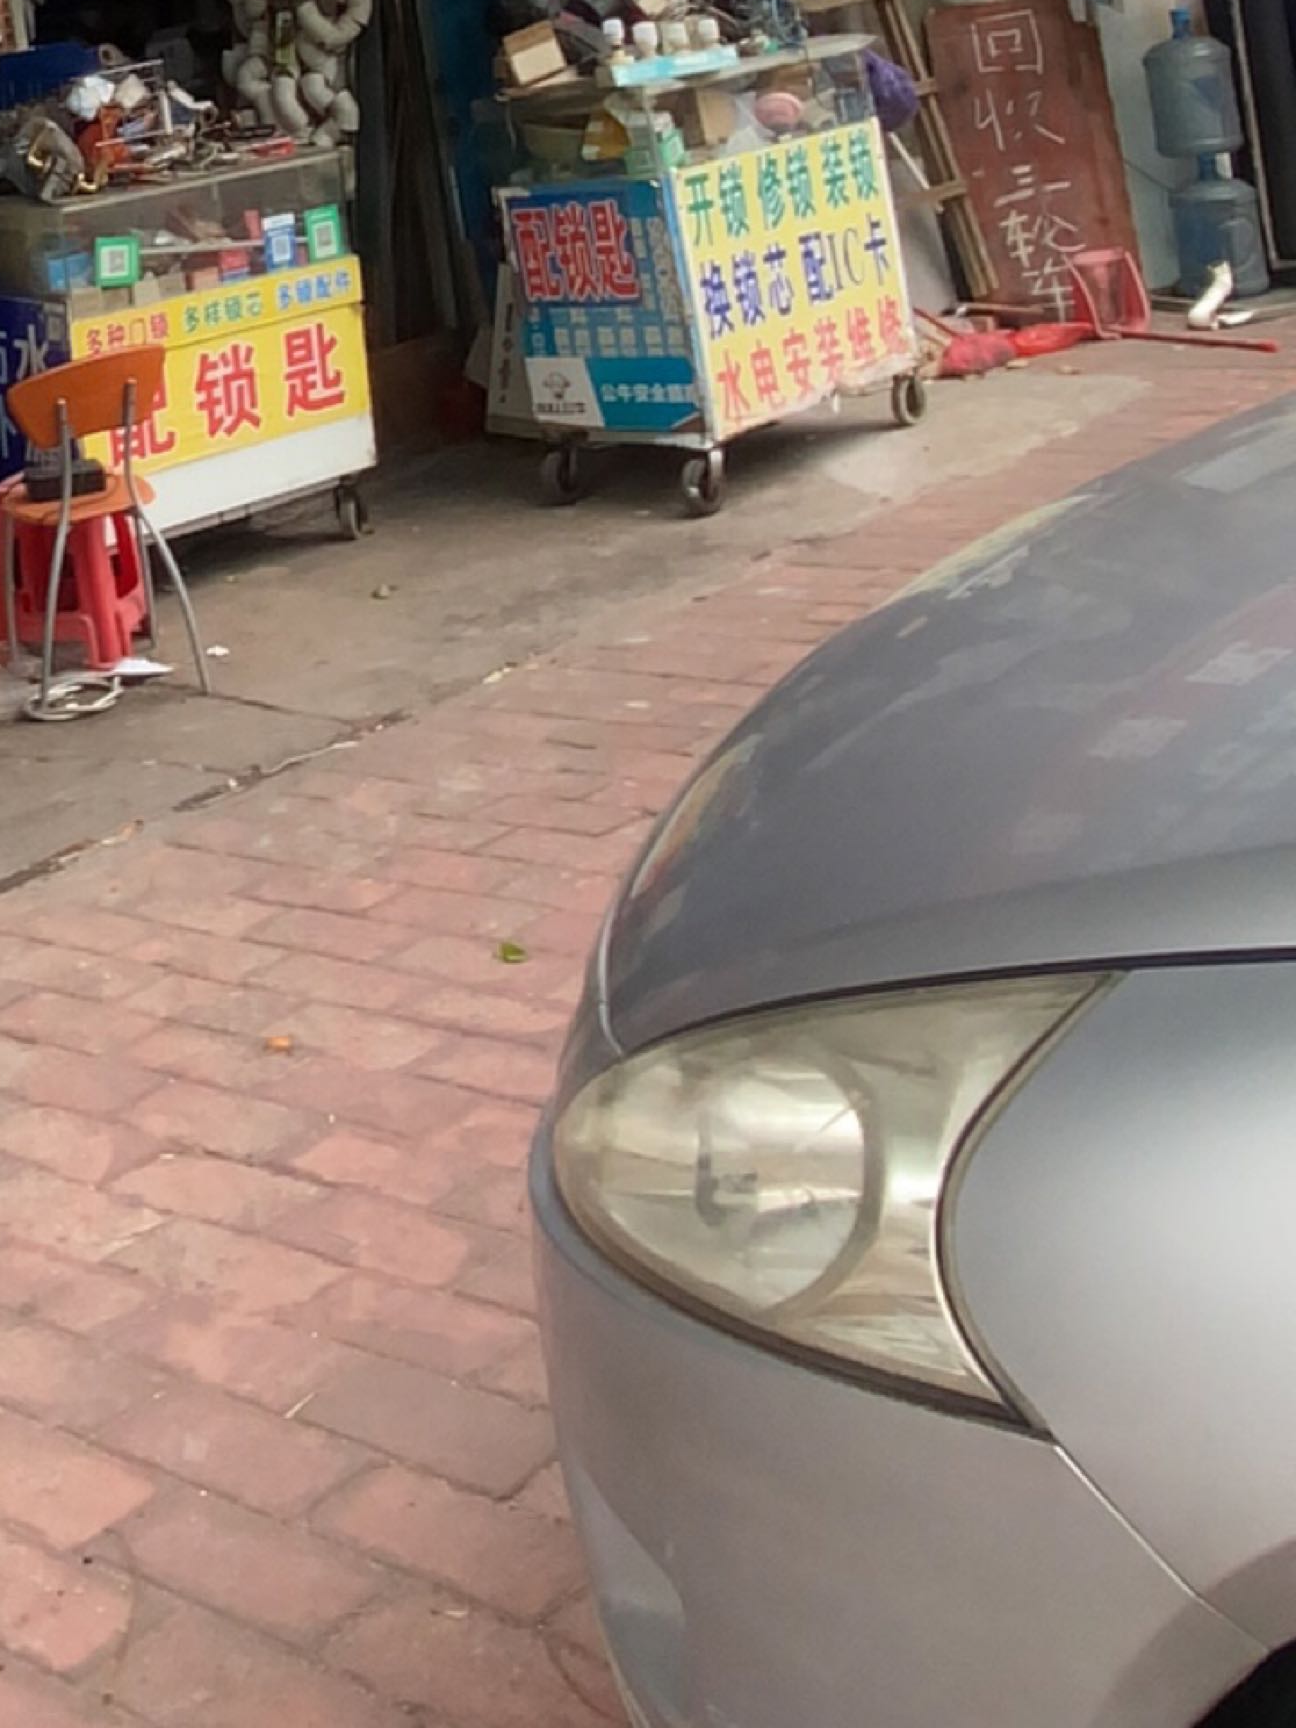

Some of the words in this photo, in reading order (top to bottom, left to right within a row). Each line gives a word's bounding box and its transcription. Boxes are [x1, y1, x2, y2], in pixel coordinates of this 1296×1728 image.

[684, 160, 750, 247] 开锁
[757, 144, 817, 231] 修锁
[819, 129, 879, 209] 装锁
[511, 198, 641, 303] 配锁匙
[700, 241, 794, 340] 换锁芯
[798, 212, 892, 306] 配IC卡
